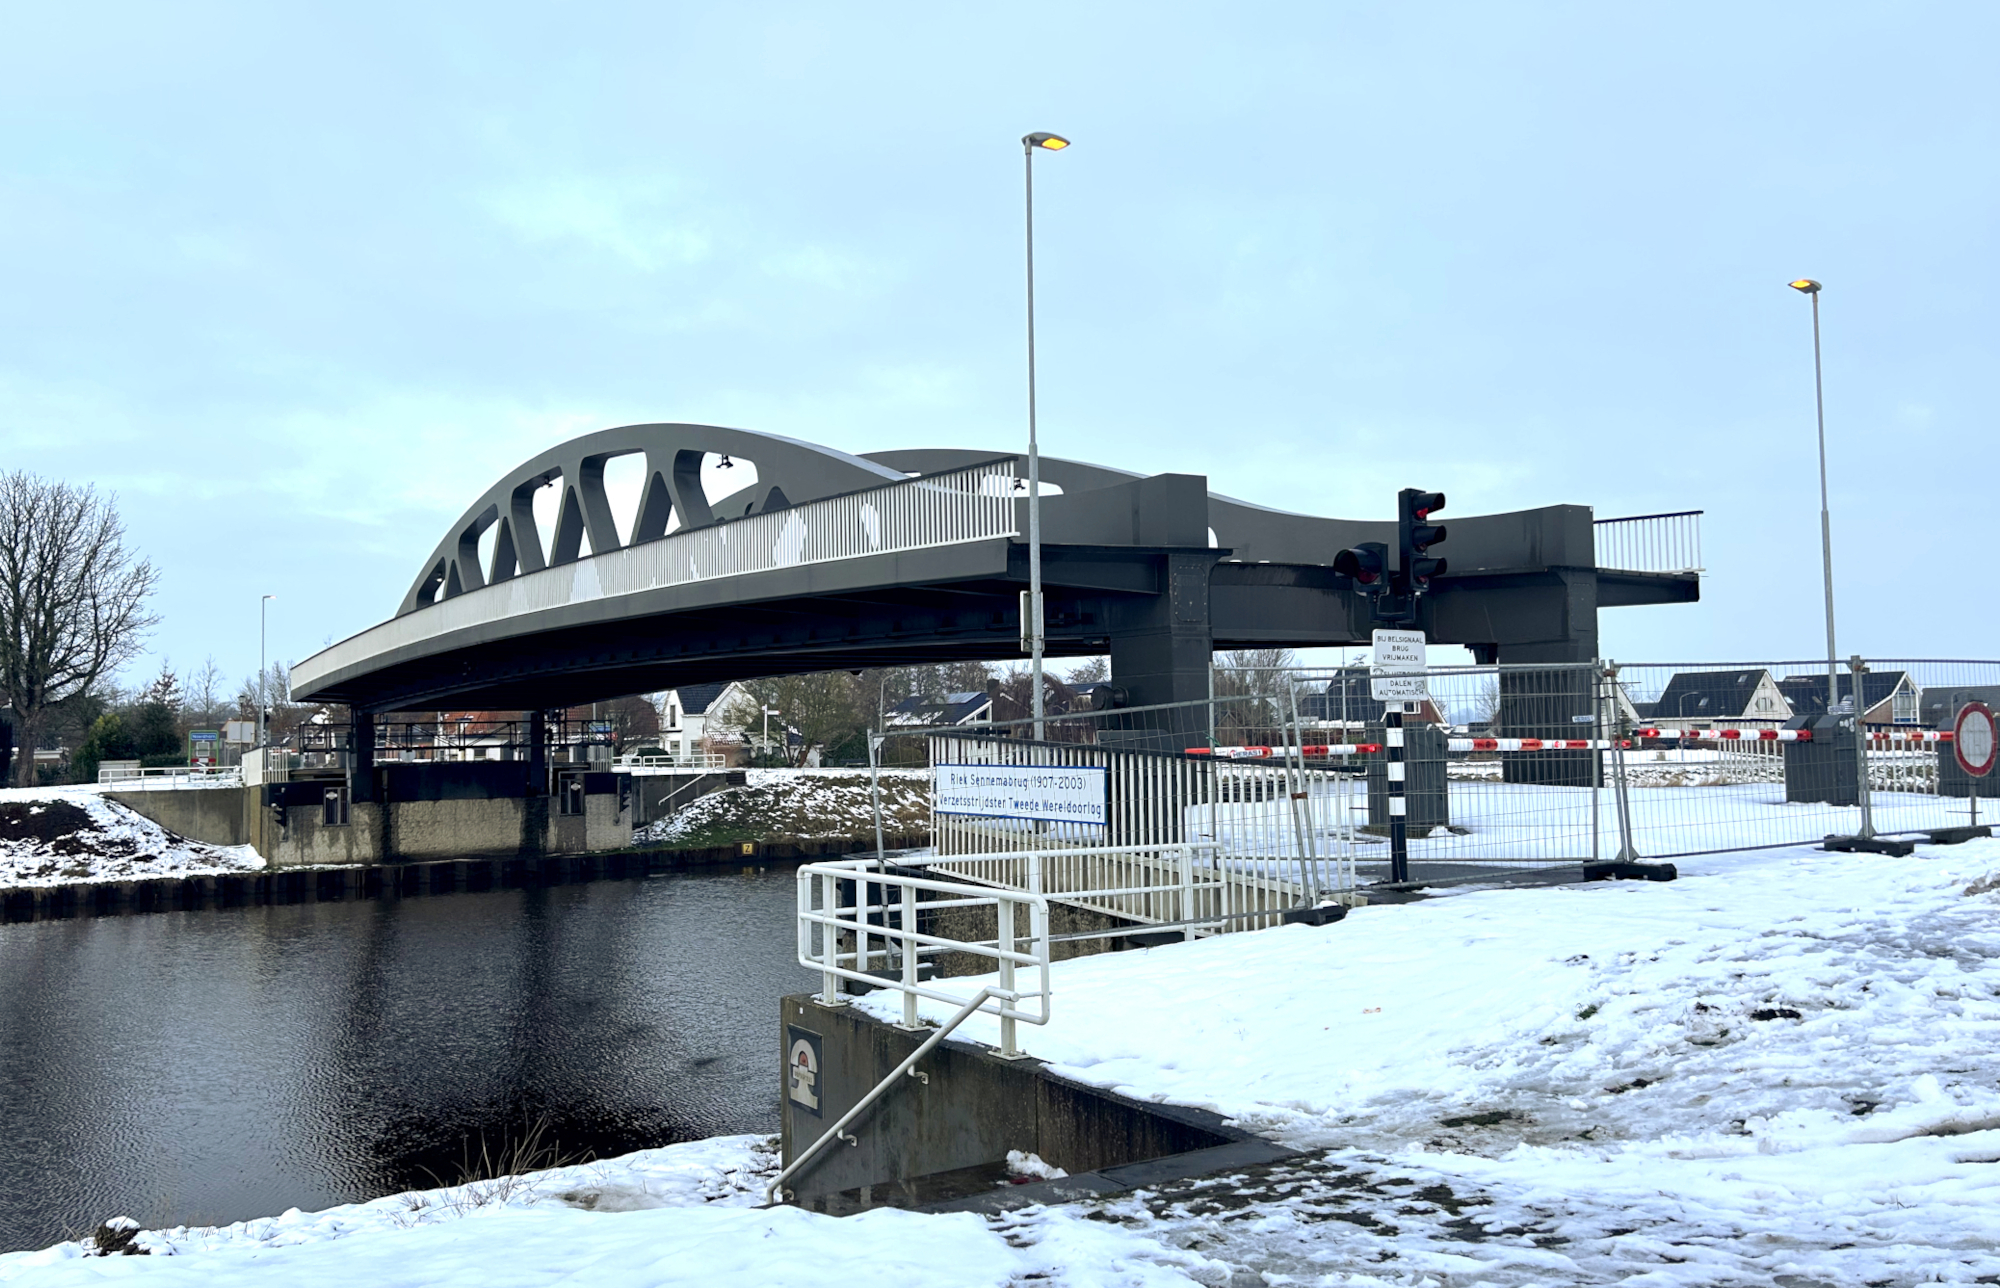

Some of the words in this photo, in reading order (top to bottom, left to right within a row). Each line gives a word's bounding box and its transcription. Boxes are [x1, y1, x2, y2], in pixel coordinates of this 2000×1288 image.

[950, 773, 968, 786] Riek
[970, 774, 1028, 791] Sennemabrug
[1030, 776, 1086, 790] (1907-2003)
[939, 794, 1006, 811] Verzetsstrijdster
[1008, 797, 1039, 811] Tweede
[1042, 801, 1101, 819] Wereldoorlog
